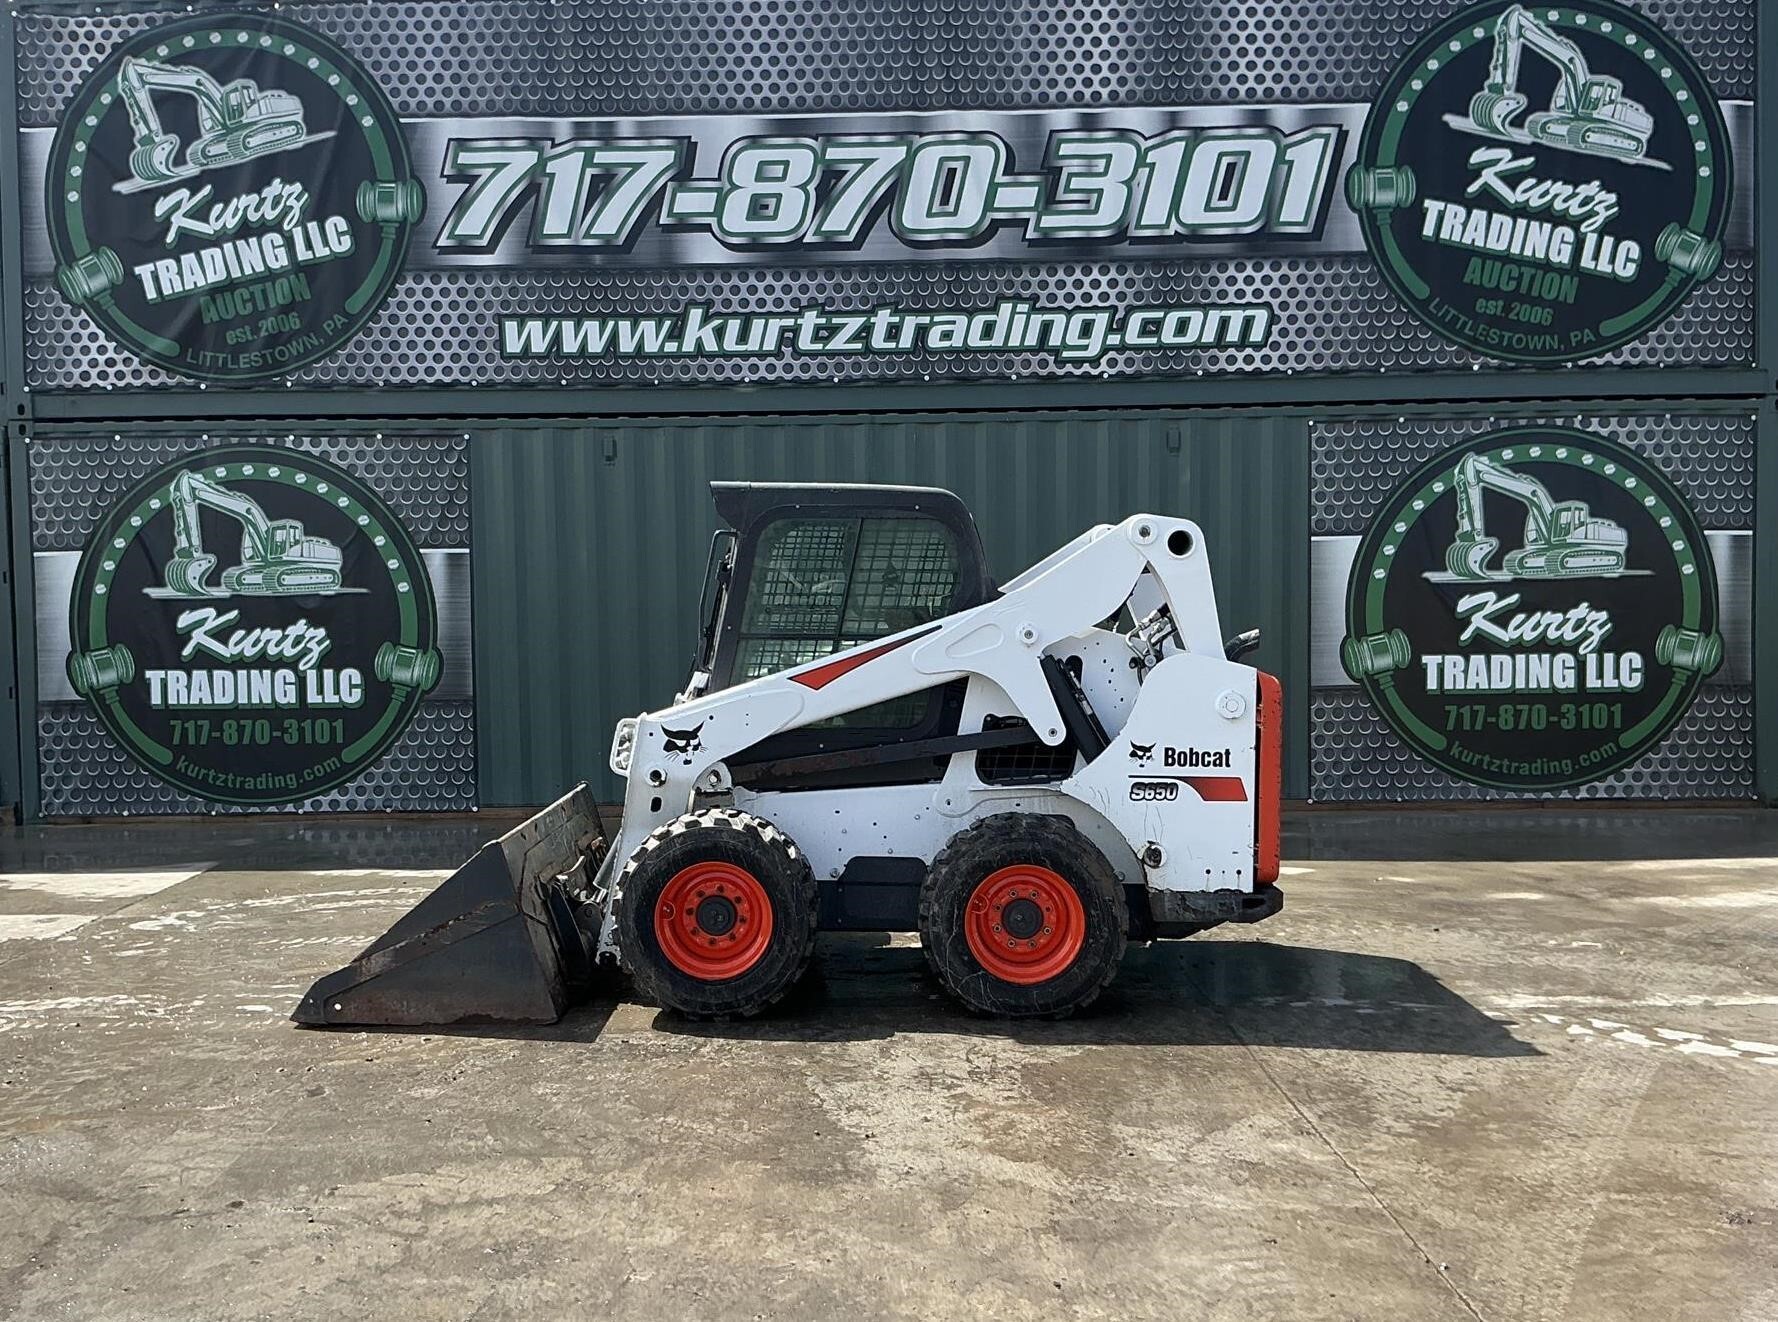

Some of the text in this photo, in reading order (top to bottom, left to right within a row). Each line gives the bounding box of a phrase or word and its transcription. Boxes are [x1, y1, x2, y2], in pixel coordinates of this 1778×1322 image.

[438, 127, 1339, 246] 717-870-3101
[1465, 147, 1620, 232] Kurtz
[155, 178, 309, 247] Kurtz
[134, 216, 354, 302] TRADING LLC
[1421, 199, 1642, 282] TRADING LLC
[202, 273, 312, 325] AUCTION
[1464, 256, 1579, 304] AUCTION
[226, 313, 302, 346] est. 2006
[502, 301, 1269, 361] www.kurtztrading.com
[1428, 298, 1596, 351] LITTLESTOWN, PA
[1475, 299, 1554, 327] est. 2006
[186, 313, 350, 370] LITTLESTOWN, PA
[176, 606, 332, 670] Kurtz
[1456, 591, 1614, 655] Kurtz
[145, 667, 366, 710] TRADING LLC
[1421, 651, 1645, 695] TRADING LLC
[169, 717, 345, 746] 717-870-3101
[1444, 703, 1624, 732] 717-870-3101
[176, 753, 342, 791] kurtztrading.com
[1163, 746, 1232, 769] Bobcat
[1449, 739, 1618, 777] kurtztrading.com
[1130, 781, 1179, 802] S650
